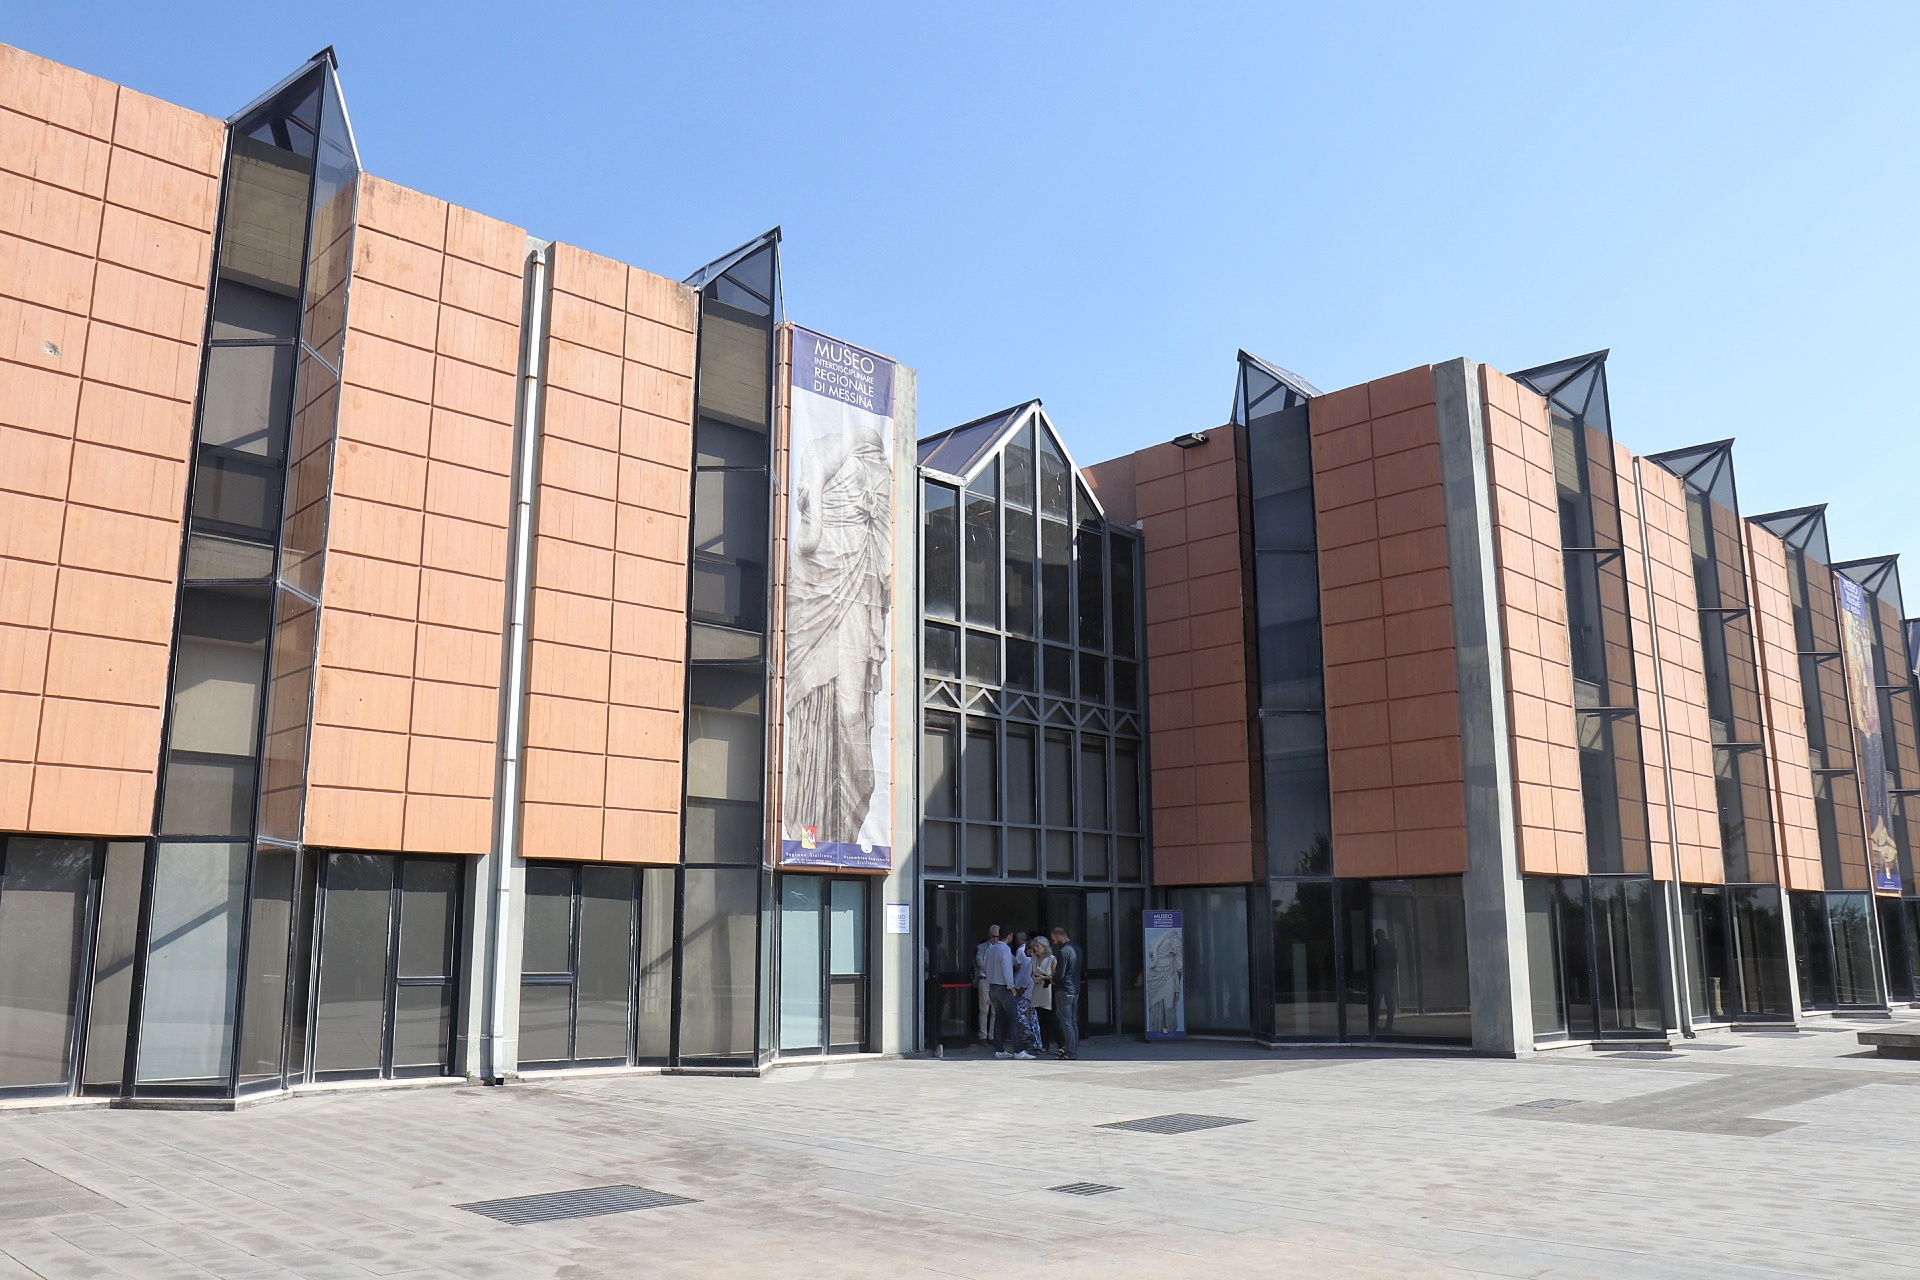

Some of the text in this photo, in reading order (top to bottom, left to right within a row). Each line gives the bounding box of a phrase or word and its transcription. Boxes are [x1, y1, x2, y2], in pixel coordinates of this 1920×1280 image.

[814, 339, 875, 374] MUSEO
[814, 356, 874, 385] INTERDISCIPLINARE
[813, 379, 874, 411] DI MESSINA
[814, 366, 874, 398] REGIONALE
